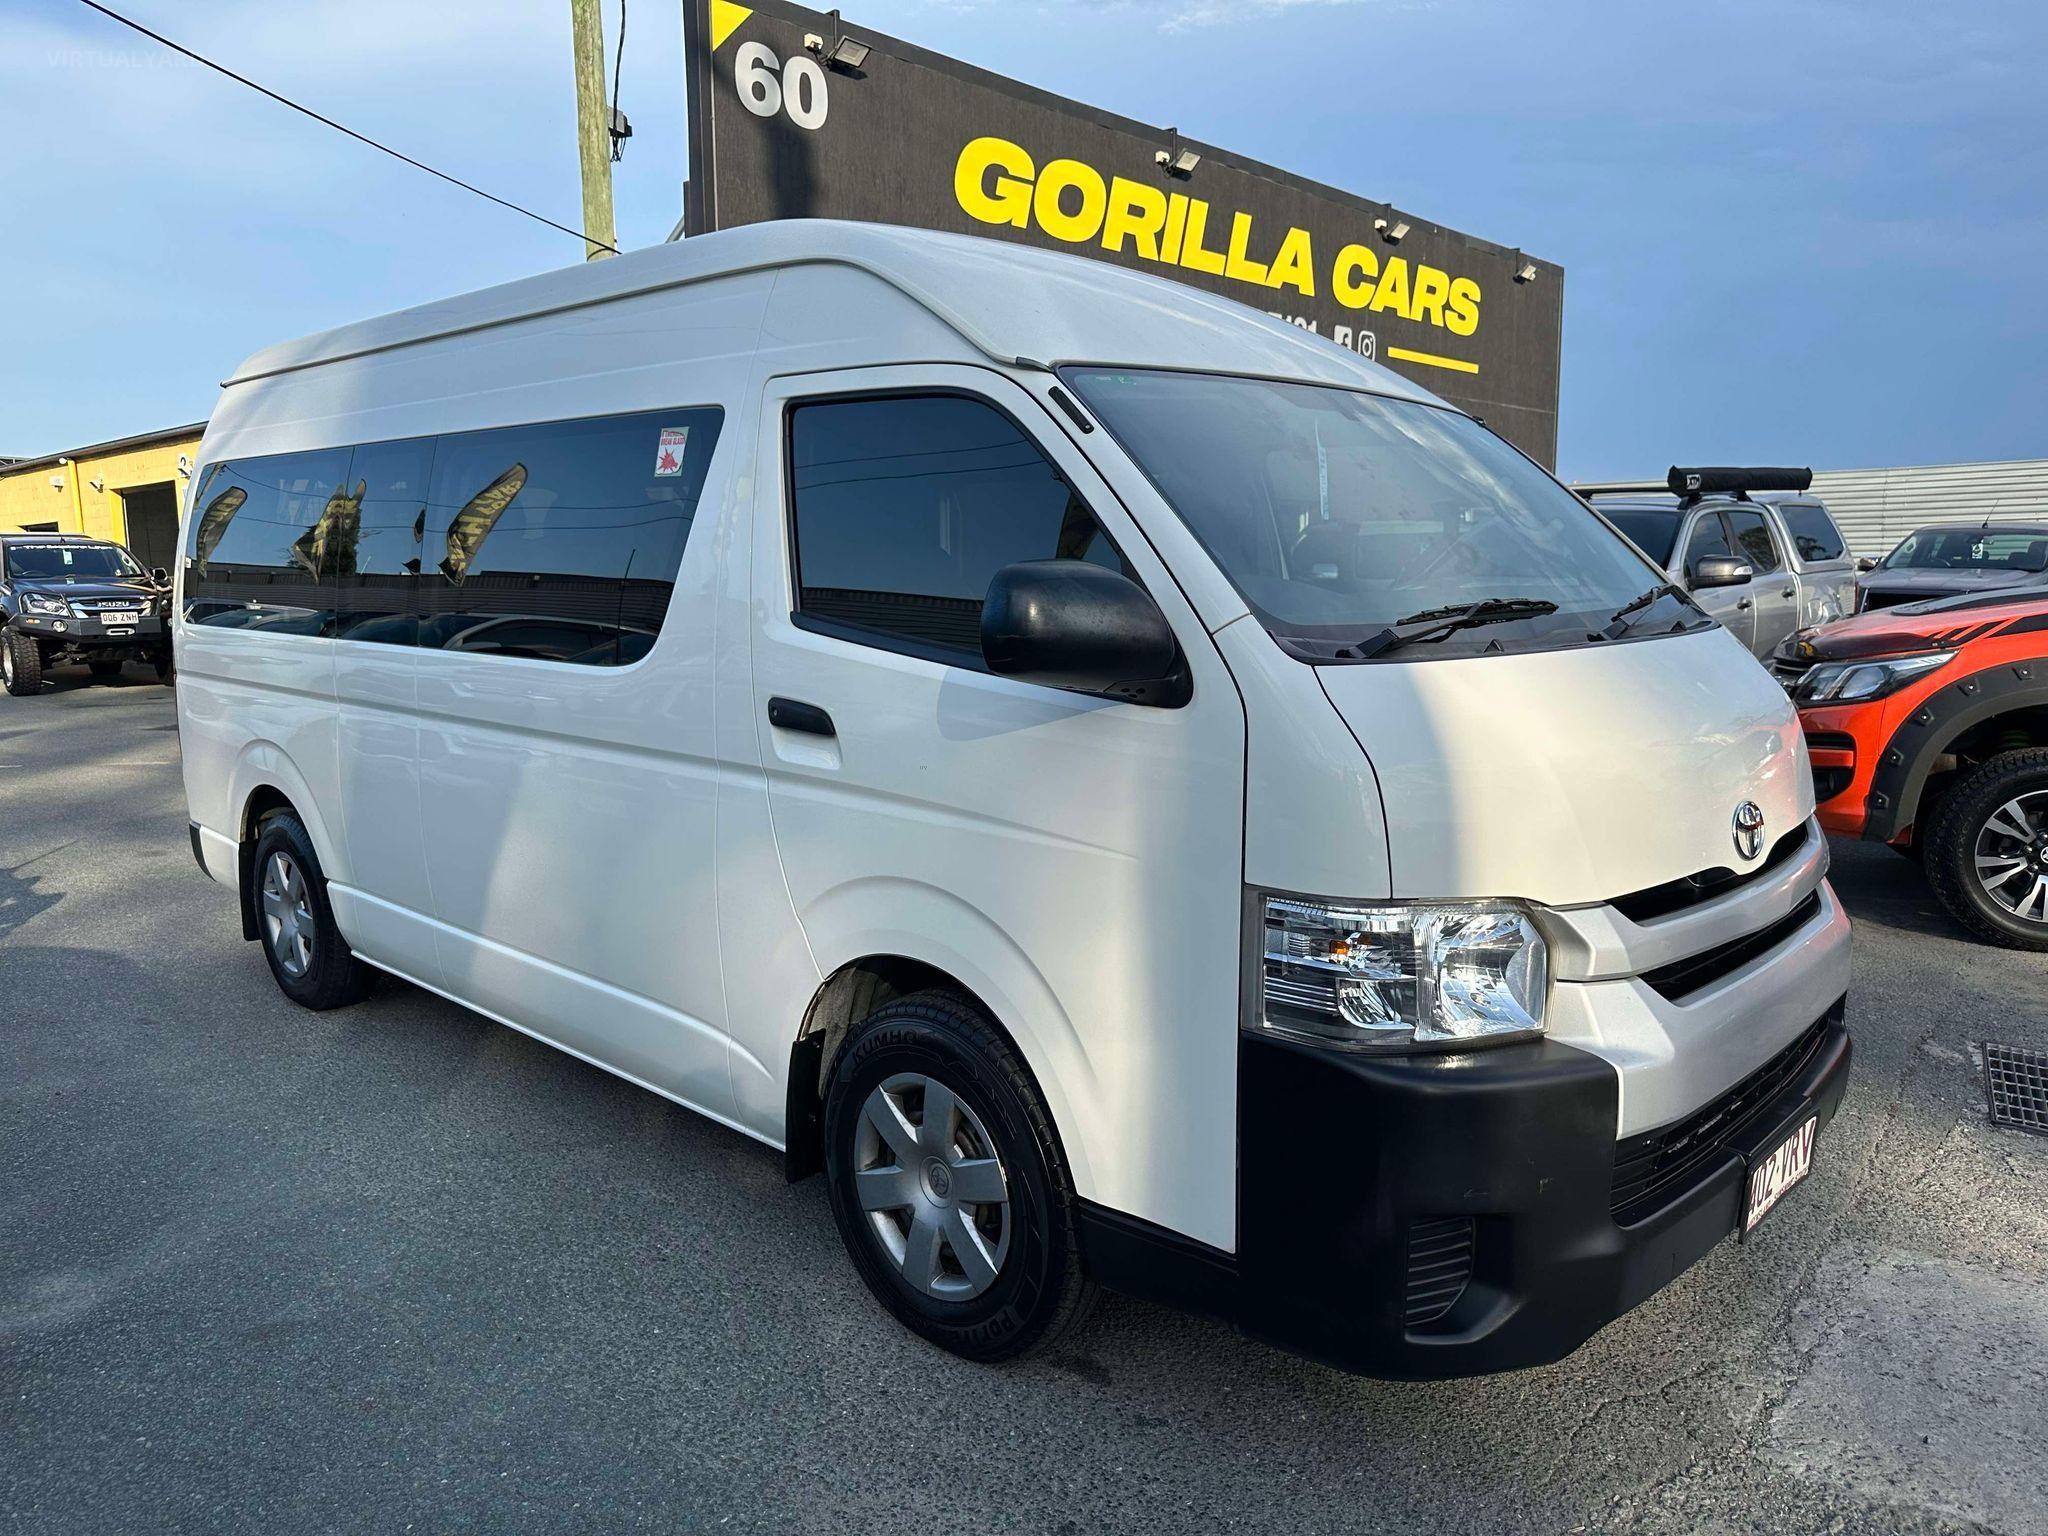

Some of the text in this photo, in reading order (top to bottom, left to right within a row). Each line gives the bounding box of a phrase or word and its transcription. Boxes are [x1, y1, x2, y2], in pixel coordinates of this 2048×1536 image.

[734, 40, 829, 131] 60
[954, 137, 1480, 336] GORILLA CARS
